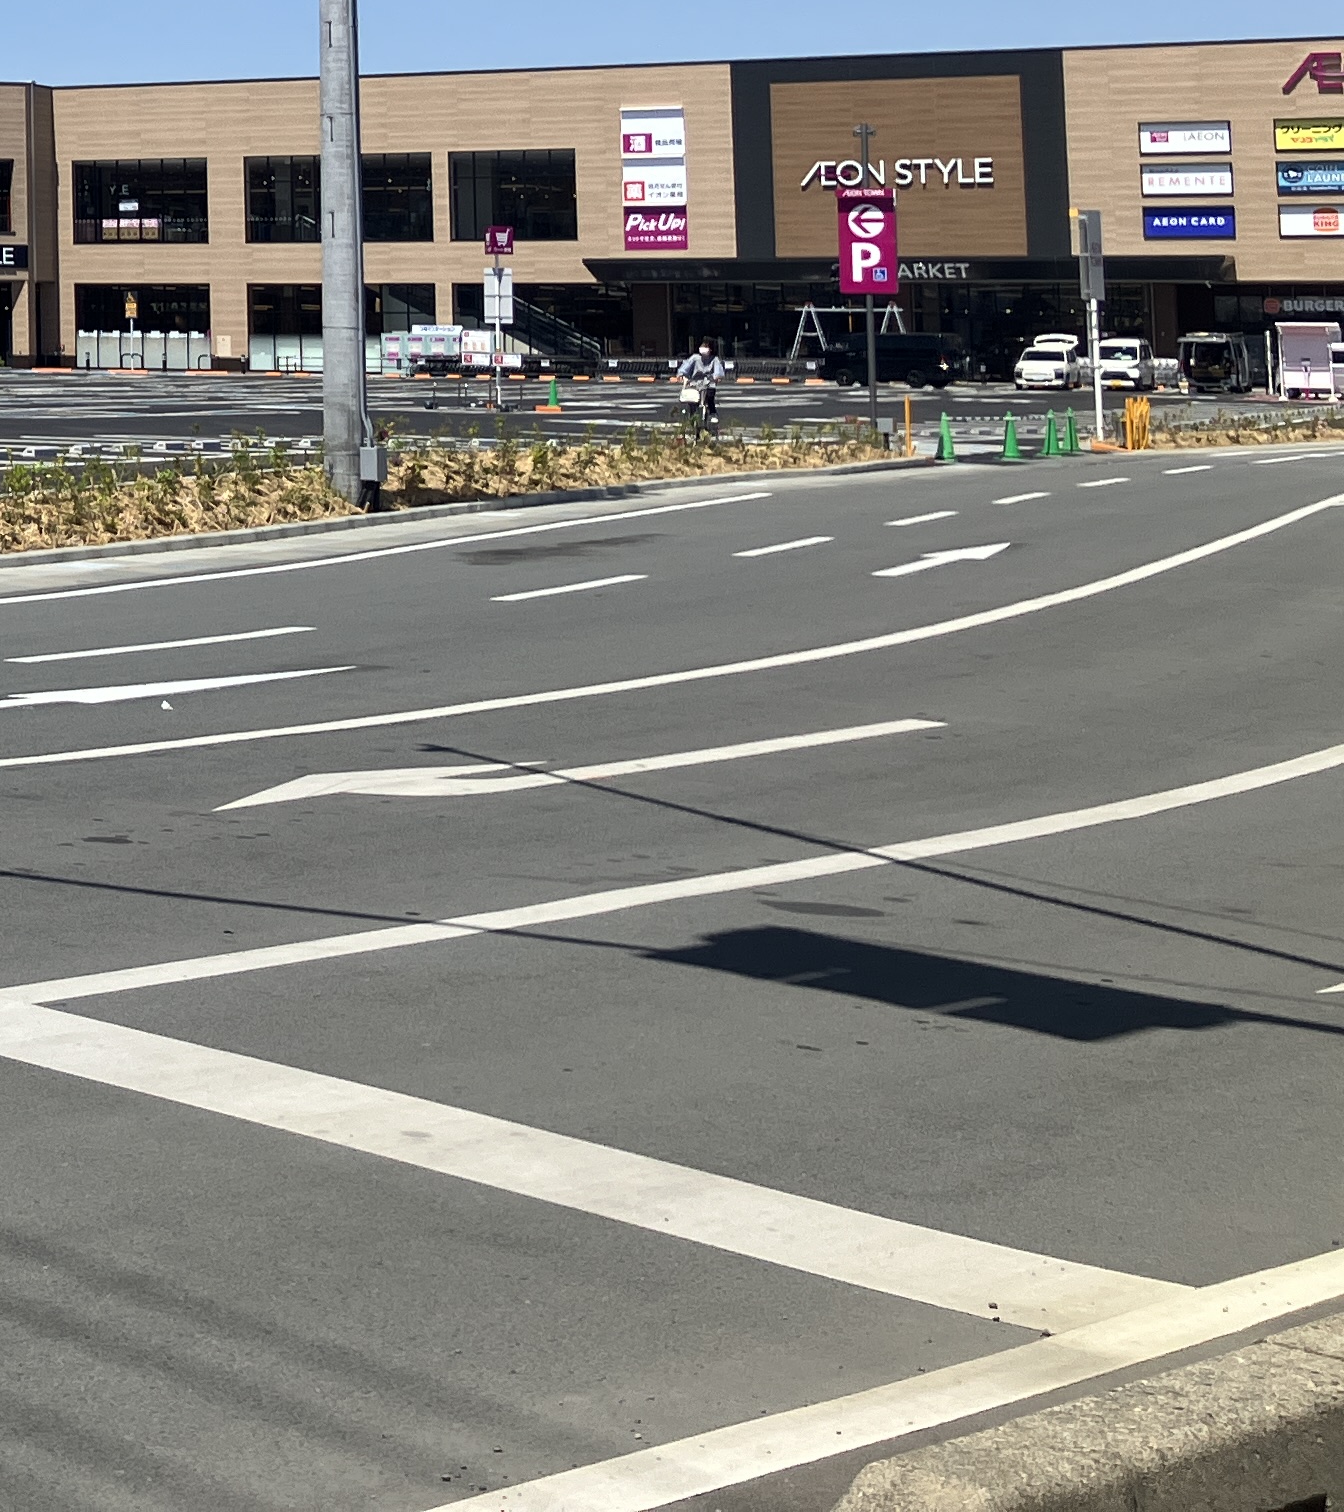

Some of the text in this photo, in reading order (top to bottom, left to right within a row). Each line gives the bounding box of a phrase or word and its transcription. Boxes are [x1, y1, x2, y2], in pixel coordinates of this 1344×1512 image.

[895, 157, 994, 185] STYLE
[1307, 173, 1344, 182] LAUN
[1148, 175, 1226, 187] REMENTE
[1153, 216, 1225, 226] AEON CARD
[851, 242, 882, 282] P
[898, 262, 970, 279] ARKET
[1283, 298, 1344, 312] BURGER
